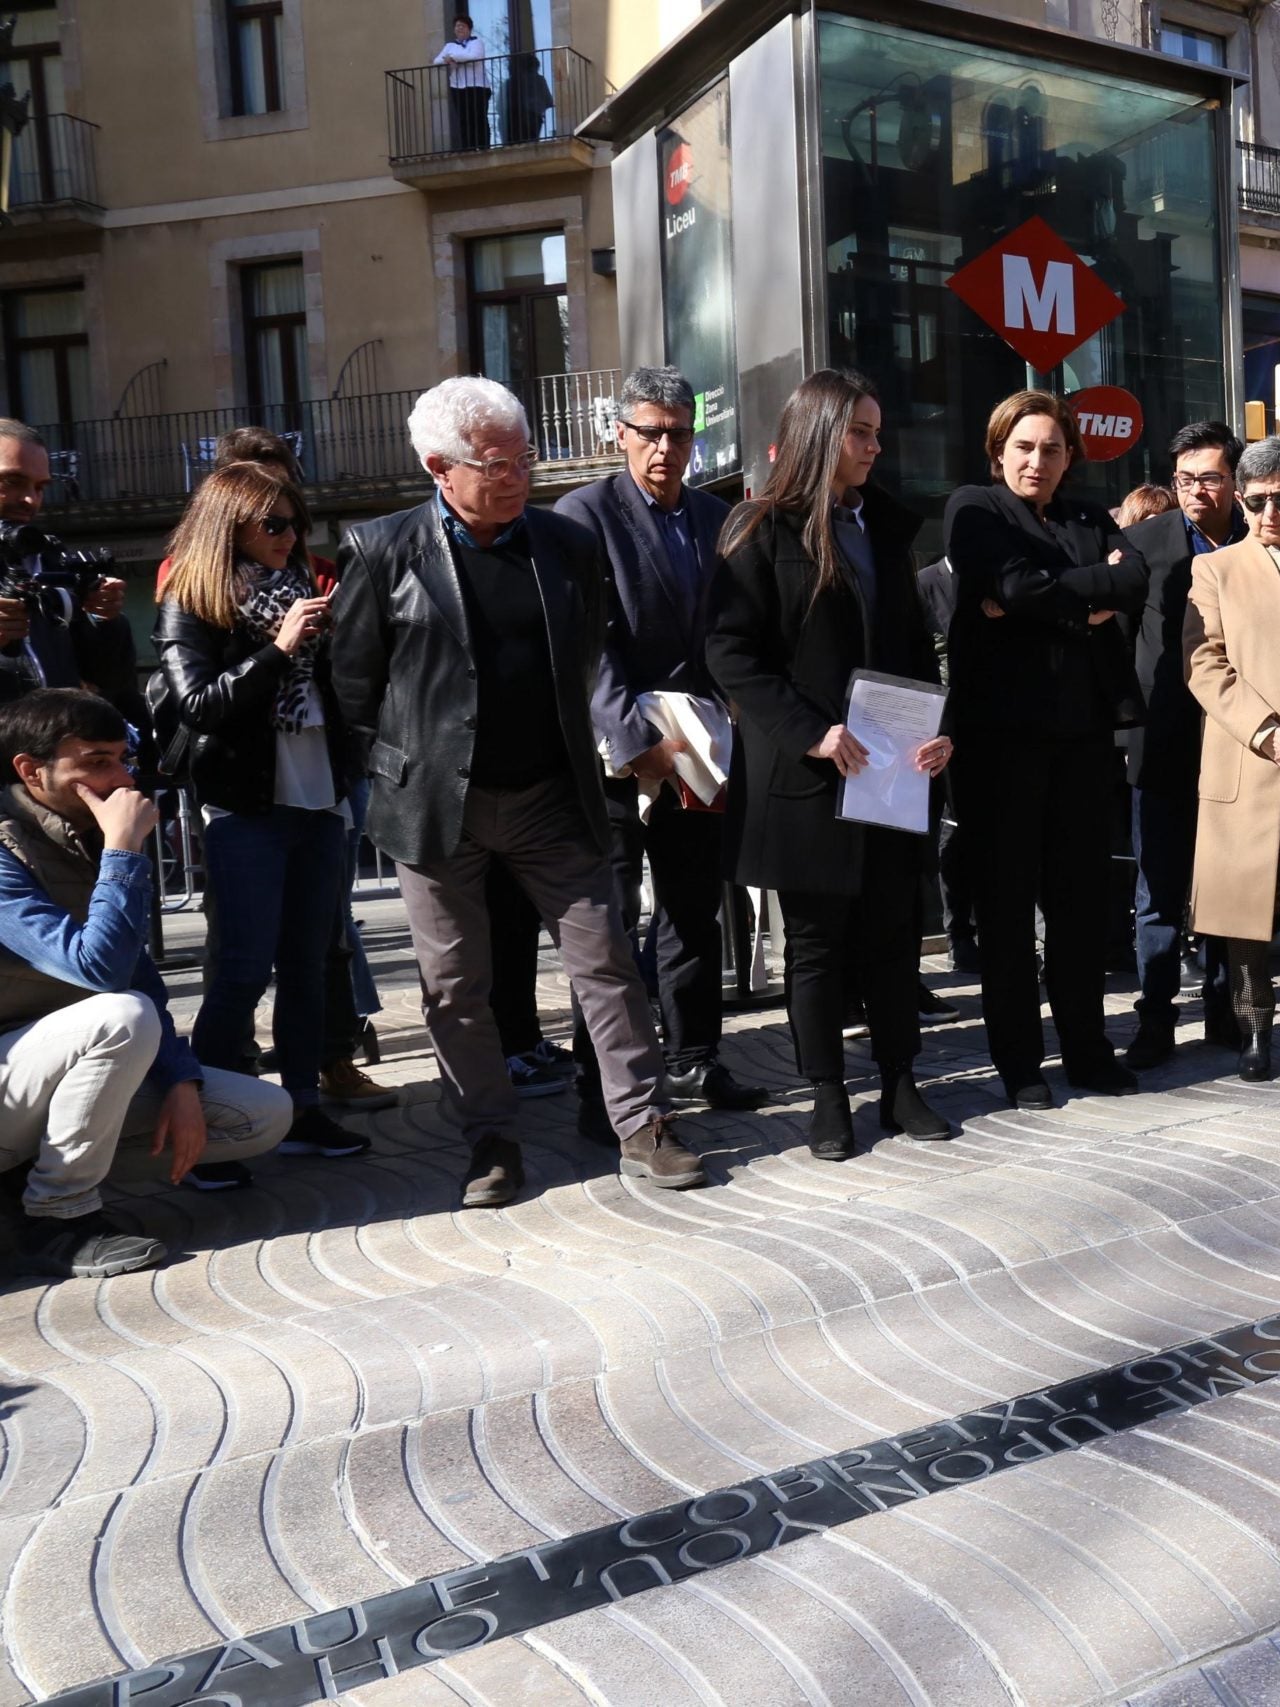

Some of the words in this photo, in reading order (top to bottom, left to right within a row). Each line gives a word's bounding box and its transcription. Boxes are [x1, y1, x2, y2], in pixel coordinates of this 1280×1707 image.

[671, 162, 689, 188] TMB
[666, 207, 696, 239] Liceu
[1002, 253, 1075, 336] M
[705, 402, 718, 415] Zona
[1077, 412, 1133, 438] TMB
[855, 1414, 1117, 1510] UPON
[114, 1603, 368, 1707] PAU
[430, 1540, 563, 1611] ET
[1122, 1337, 1240, 1385] OH
[313, 1608, 498, 1699] OH
